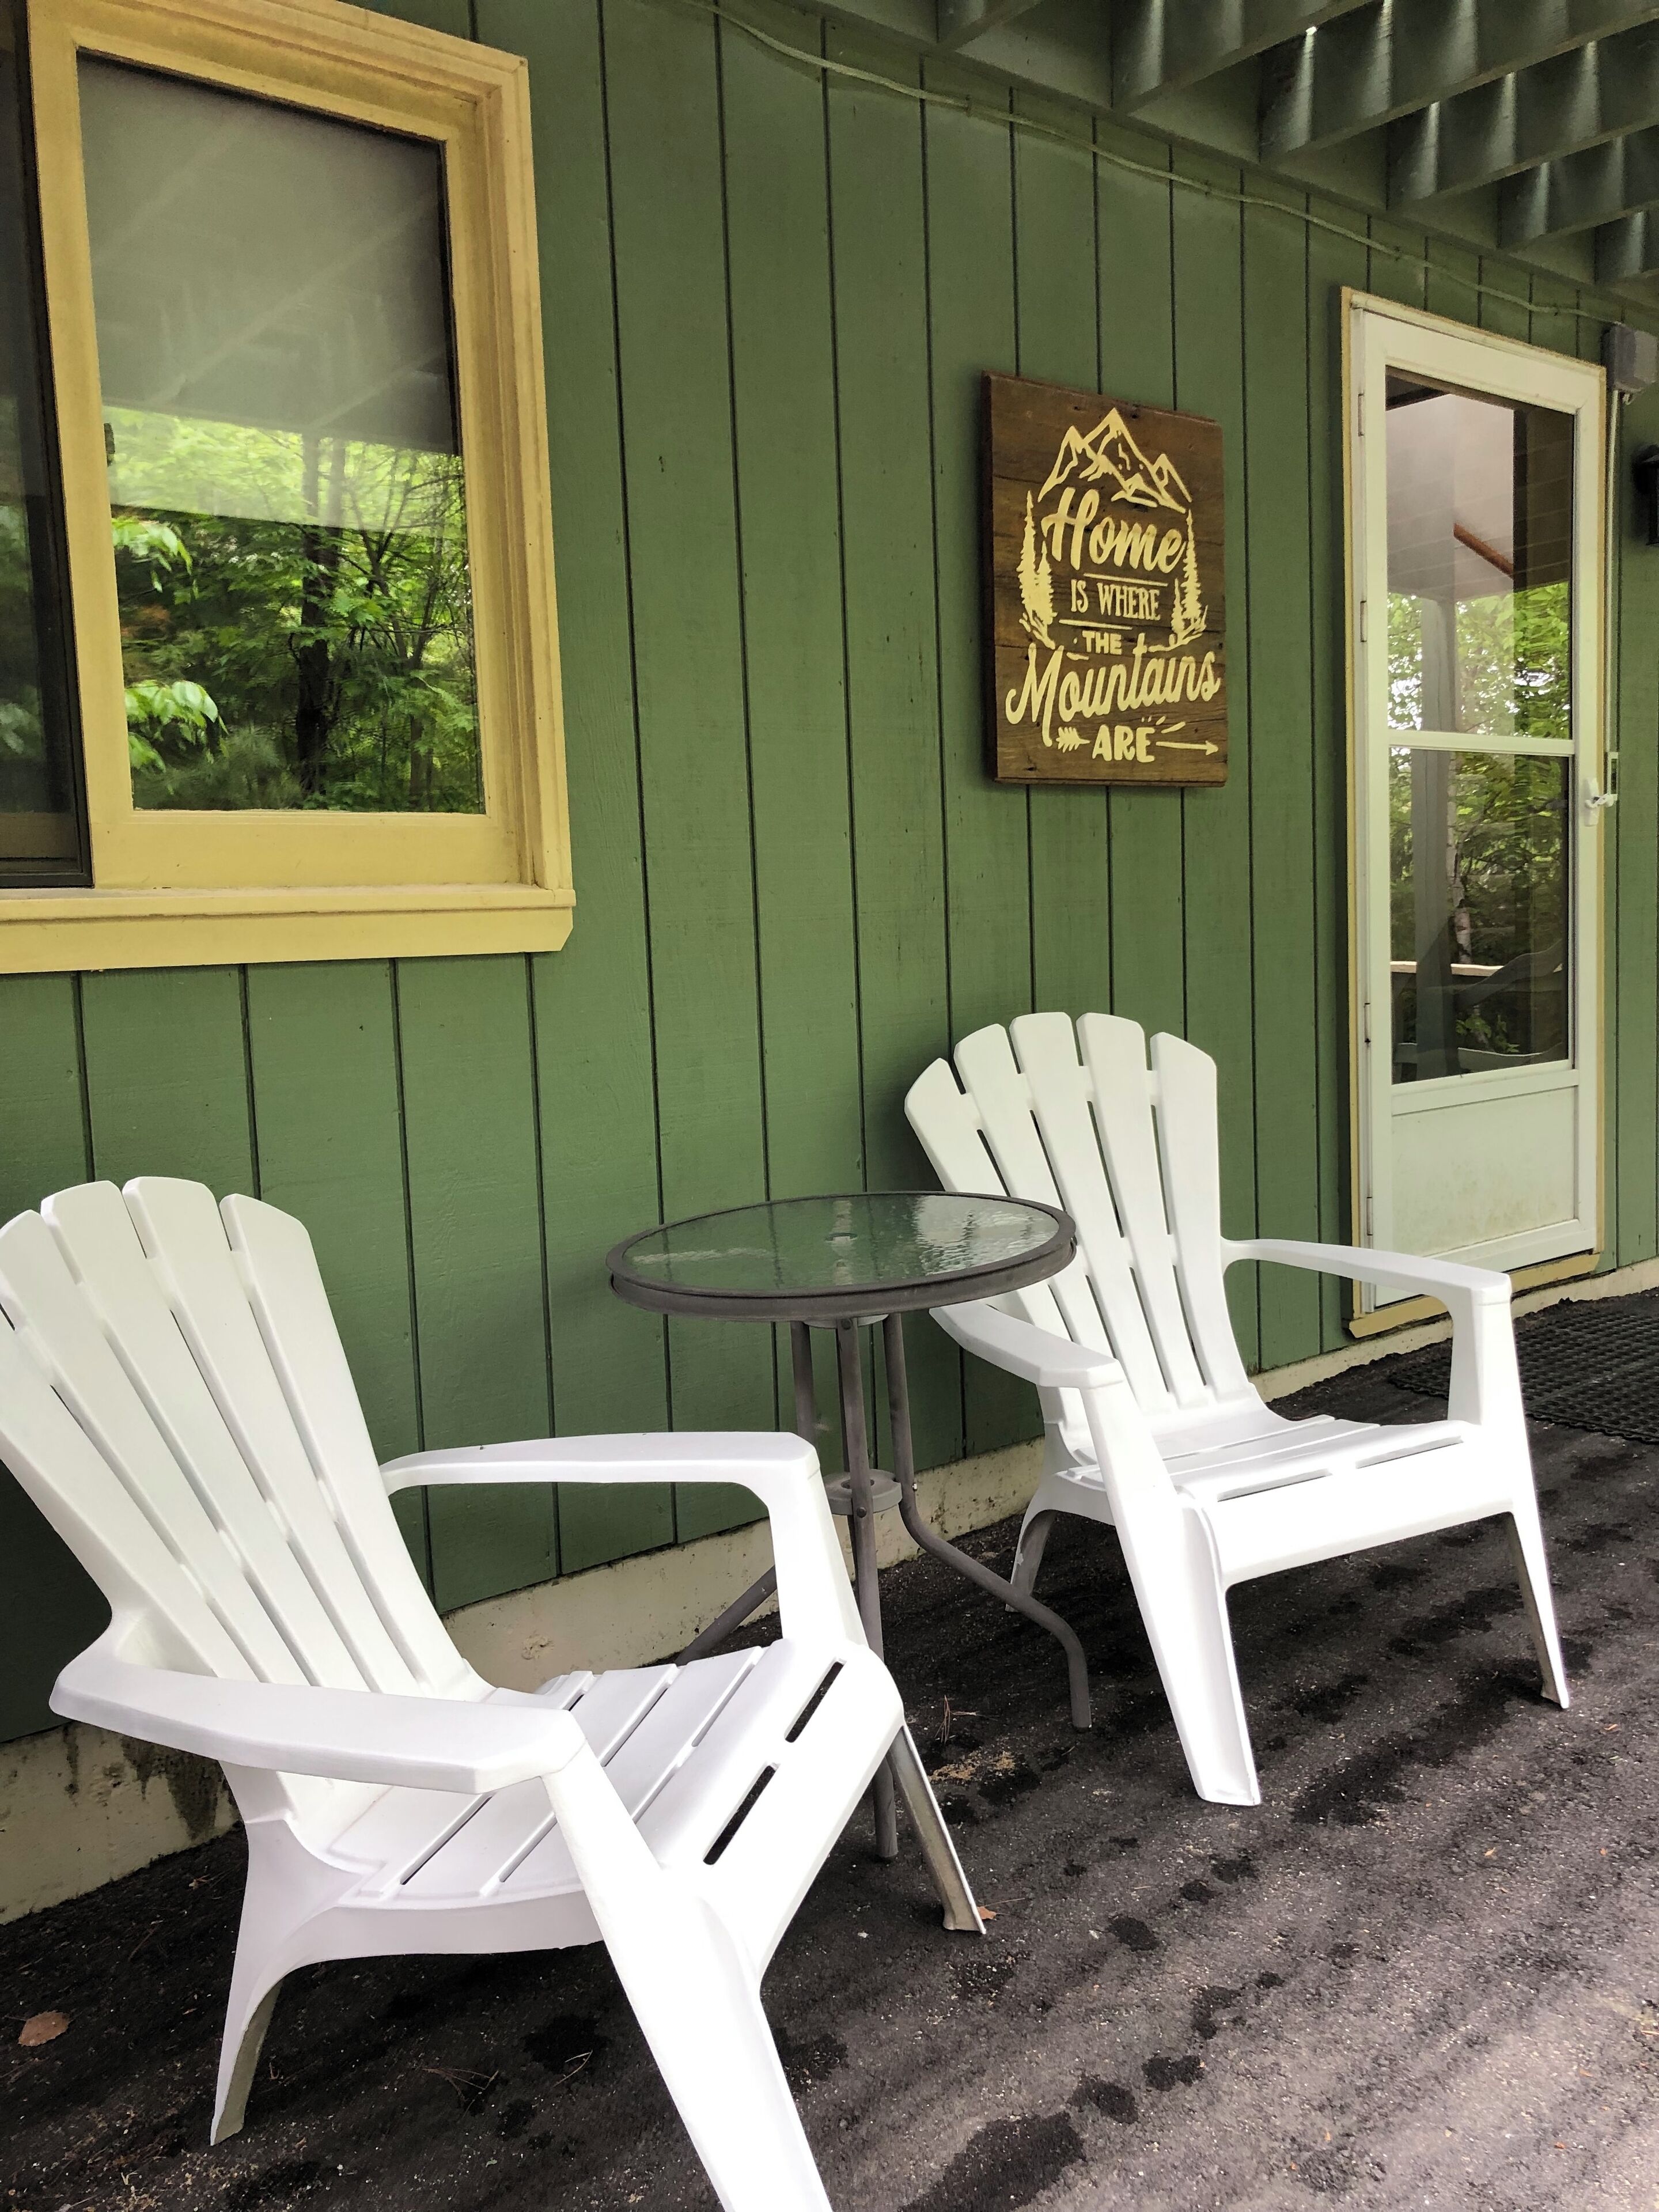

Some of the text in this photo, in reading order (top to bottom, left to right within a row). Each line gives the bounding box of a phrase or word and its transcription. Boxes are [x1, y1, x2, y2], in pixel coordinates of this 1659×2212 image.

[1041, 487, 1185, 573] Home
[1071, 579, 1160, 620] IS WHERE
[1082, 631, 1122, 655] THE
[1005, 633, 1222, 747] Mountains
[1092, 724, 1156, 763] ARE
